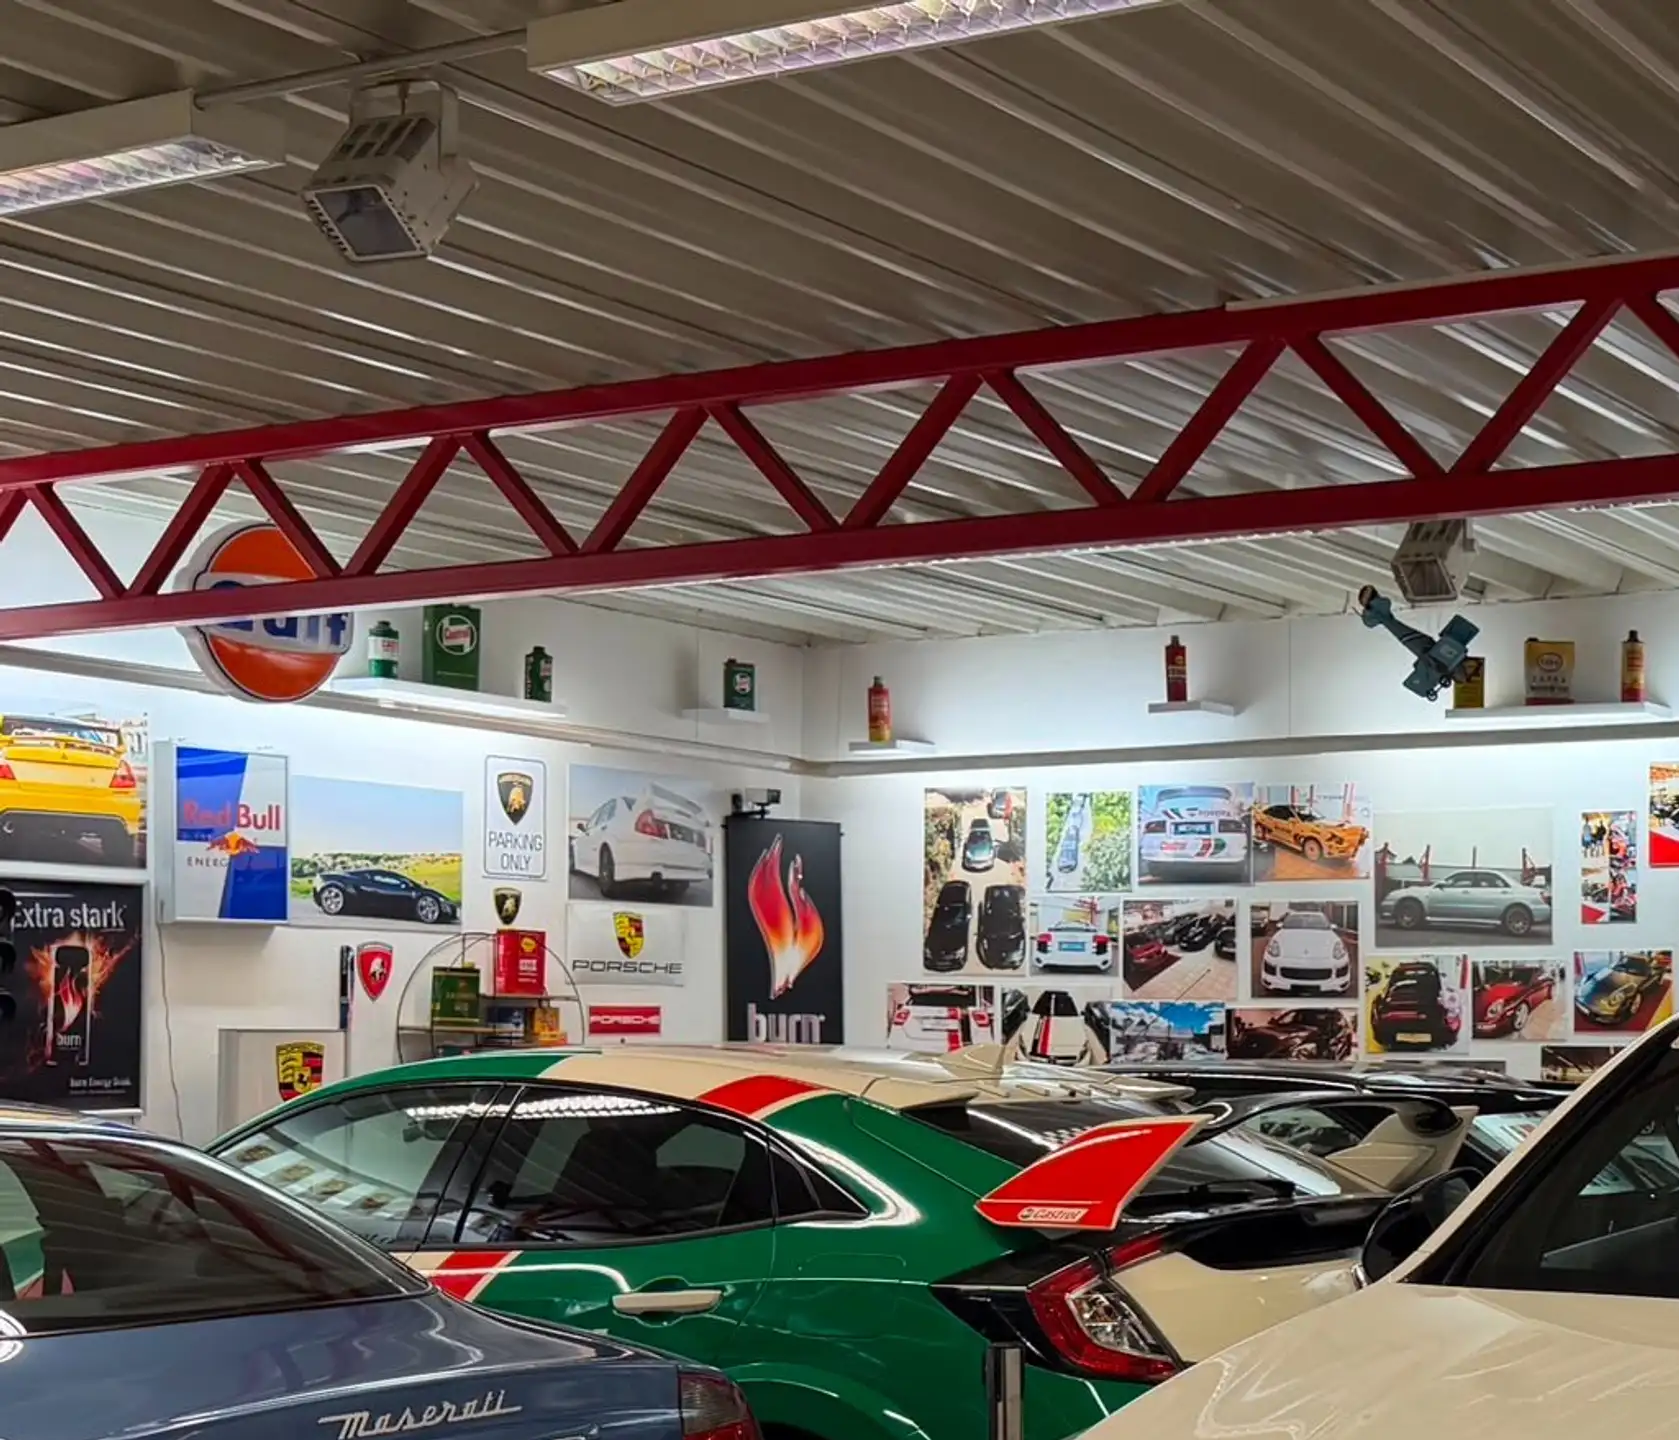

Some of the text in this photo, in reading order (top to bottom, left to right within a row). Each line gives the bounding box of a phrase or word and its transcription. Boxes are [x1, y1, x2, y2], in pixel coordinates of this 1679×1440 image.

[183, 800, 281, 831] Red Bull
[488, 831, 543, 852] PARKING
[501, 852, 531, 872] ONLY
[12, 900, 125, 929] Extra stark
[572, 960, 683, 975] PORSCHE
[590, 1015, 660, 1026] PORSCHE
[747, 1003, 822, 1044] burn
[56, 1032, 82, 1047] burn
[1032, 1208, 1083, 1221] Castrol
[318, 1389, 523, 1440] Maserati
